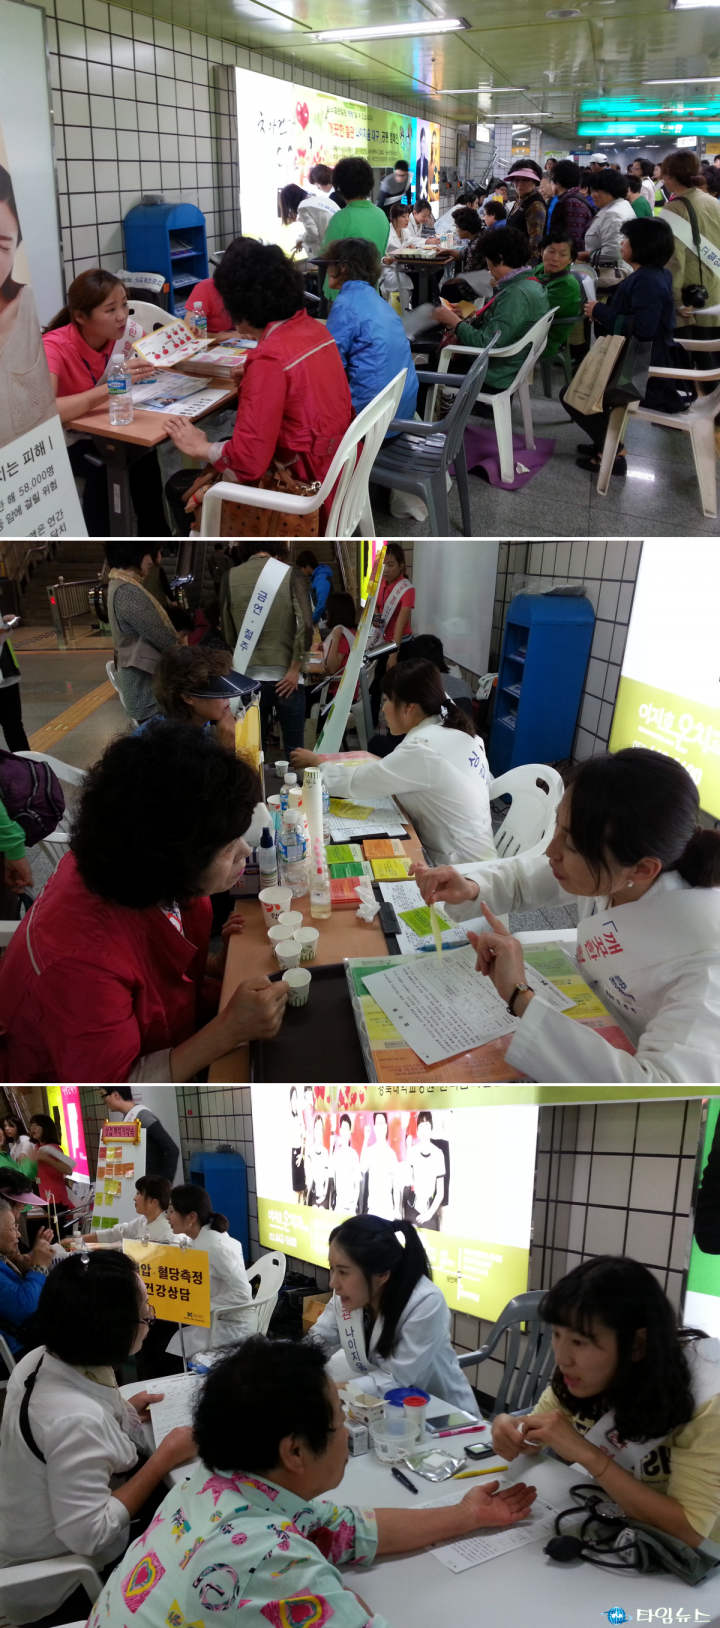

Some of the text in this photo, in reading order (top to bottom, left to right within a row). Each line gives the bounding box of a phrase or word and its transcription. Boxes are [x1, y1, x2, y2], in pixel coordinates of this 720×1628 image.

[22, 440, 46, 465] 피해
[5, 478, 58, 525] 암에 걸릴 위험
[47, 508, 64, 528] 연간
[638, 702, 676, 735] 이지호
[157, 1265, 204, 1285] 혈당측정
